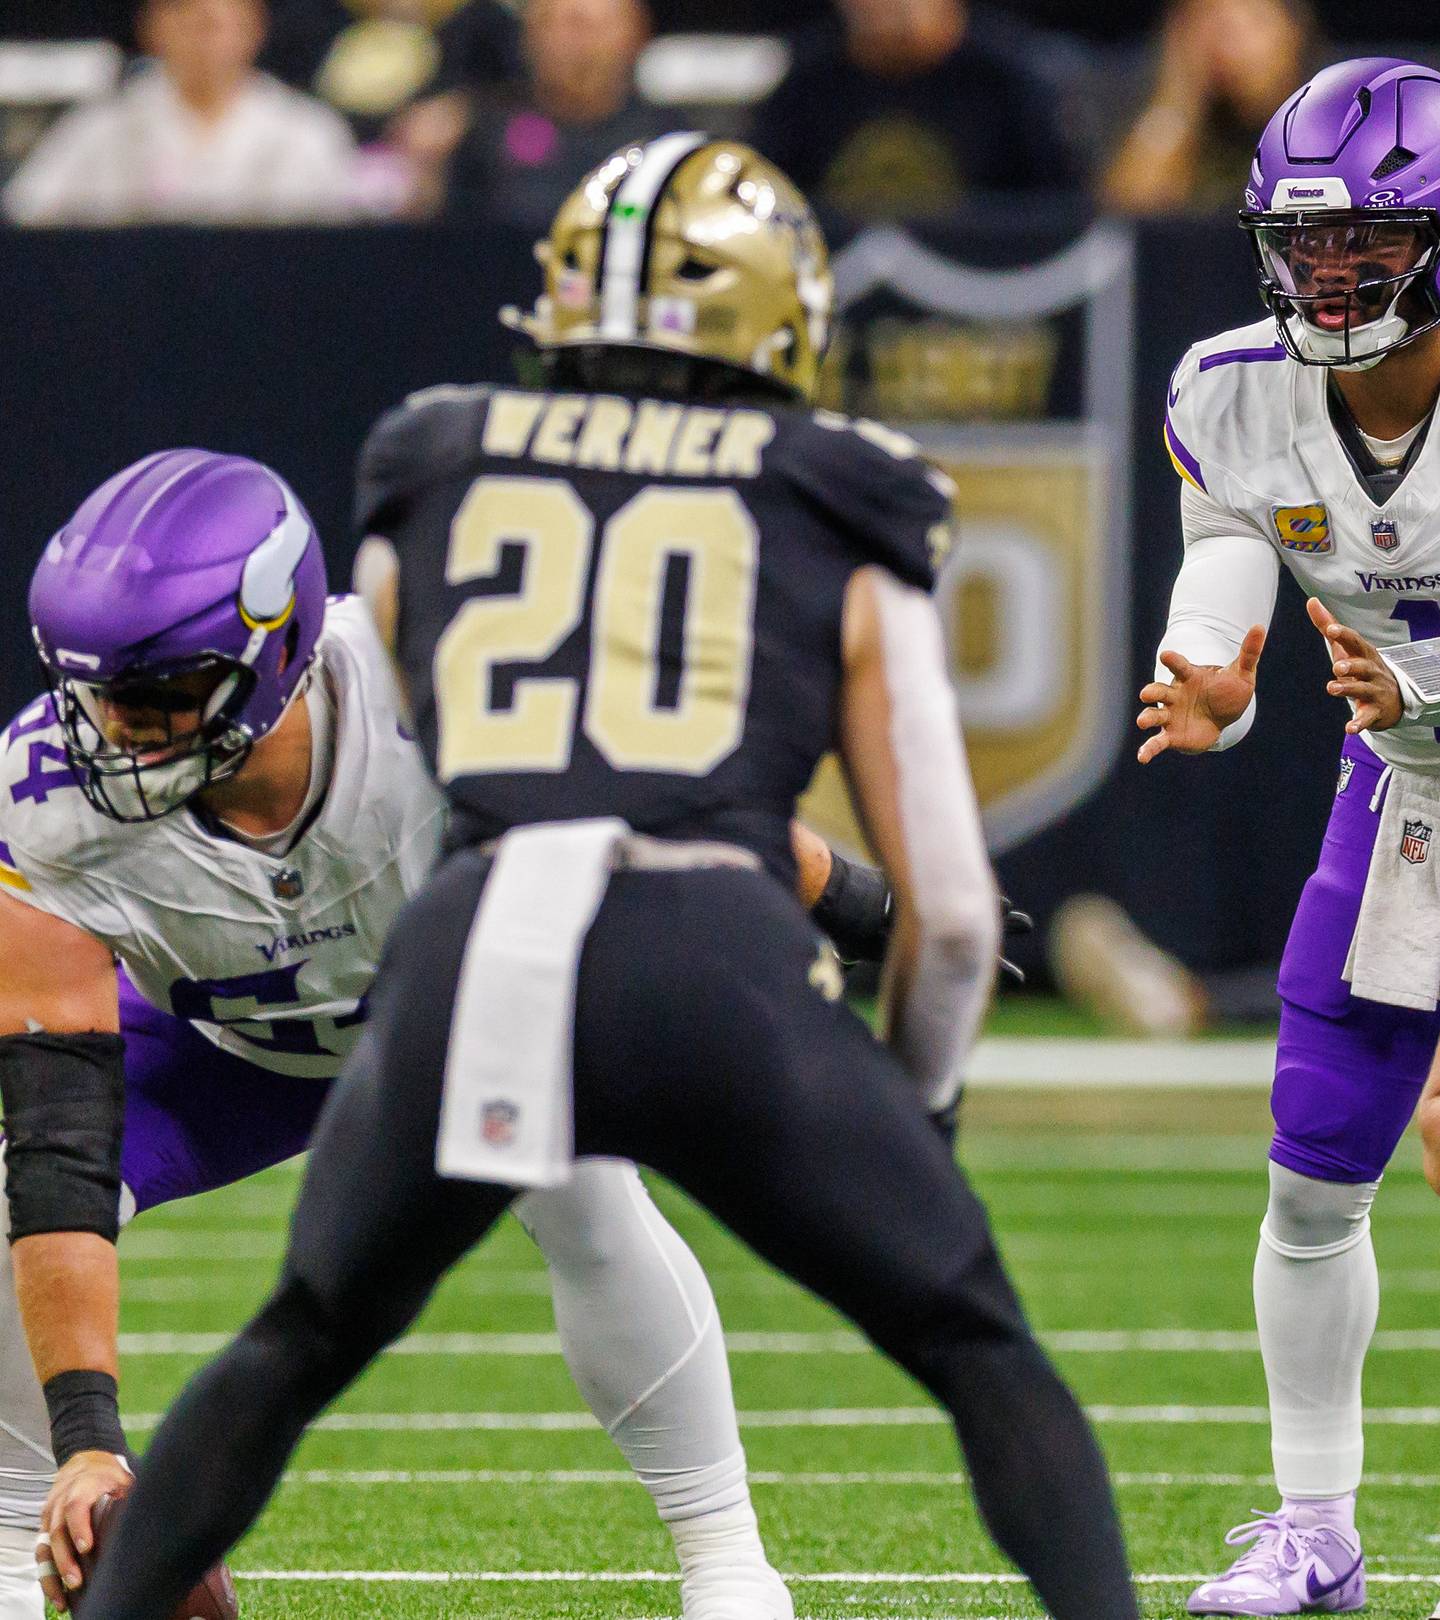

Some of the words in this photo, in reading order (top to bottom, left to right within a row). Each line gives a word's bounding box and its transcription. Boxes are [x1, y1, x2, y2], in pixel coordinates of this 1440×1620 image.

[481, 390, 776, 479] WERNER
[1277, 506, 1329, 544] C
[1375, 533, 1397, 548] NFL
[432, 473, 760, 783] 20
[1402, 836, 1425, 861] NFL
